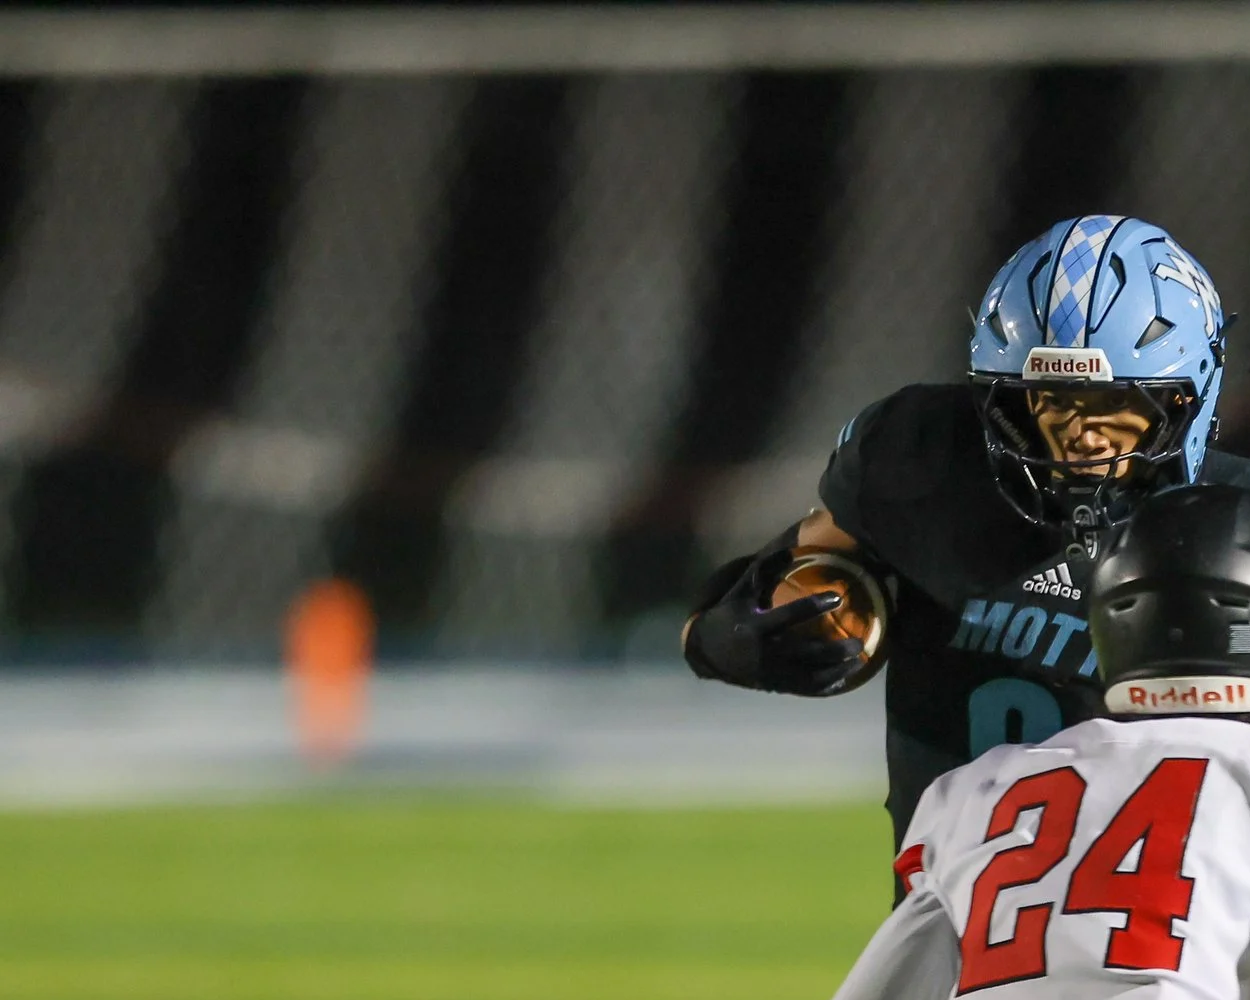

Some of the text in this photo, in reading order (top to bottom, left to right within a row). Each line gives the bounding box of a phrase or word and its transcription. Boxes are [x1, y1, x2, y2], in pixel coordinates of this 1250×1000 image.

[1030, 356, 1101, 373] Riddell
[1022, 579, 1082, 601] adidas
[1128, 684, 1246, 708] Riddell
[956, 757, 1210, 998] 24
